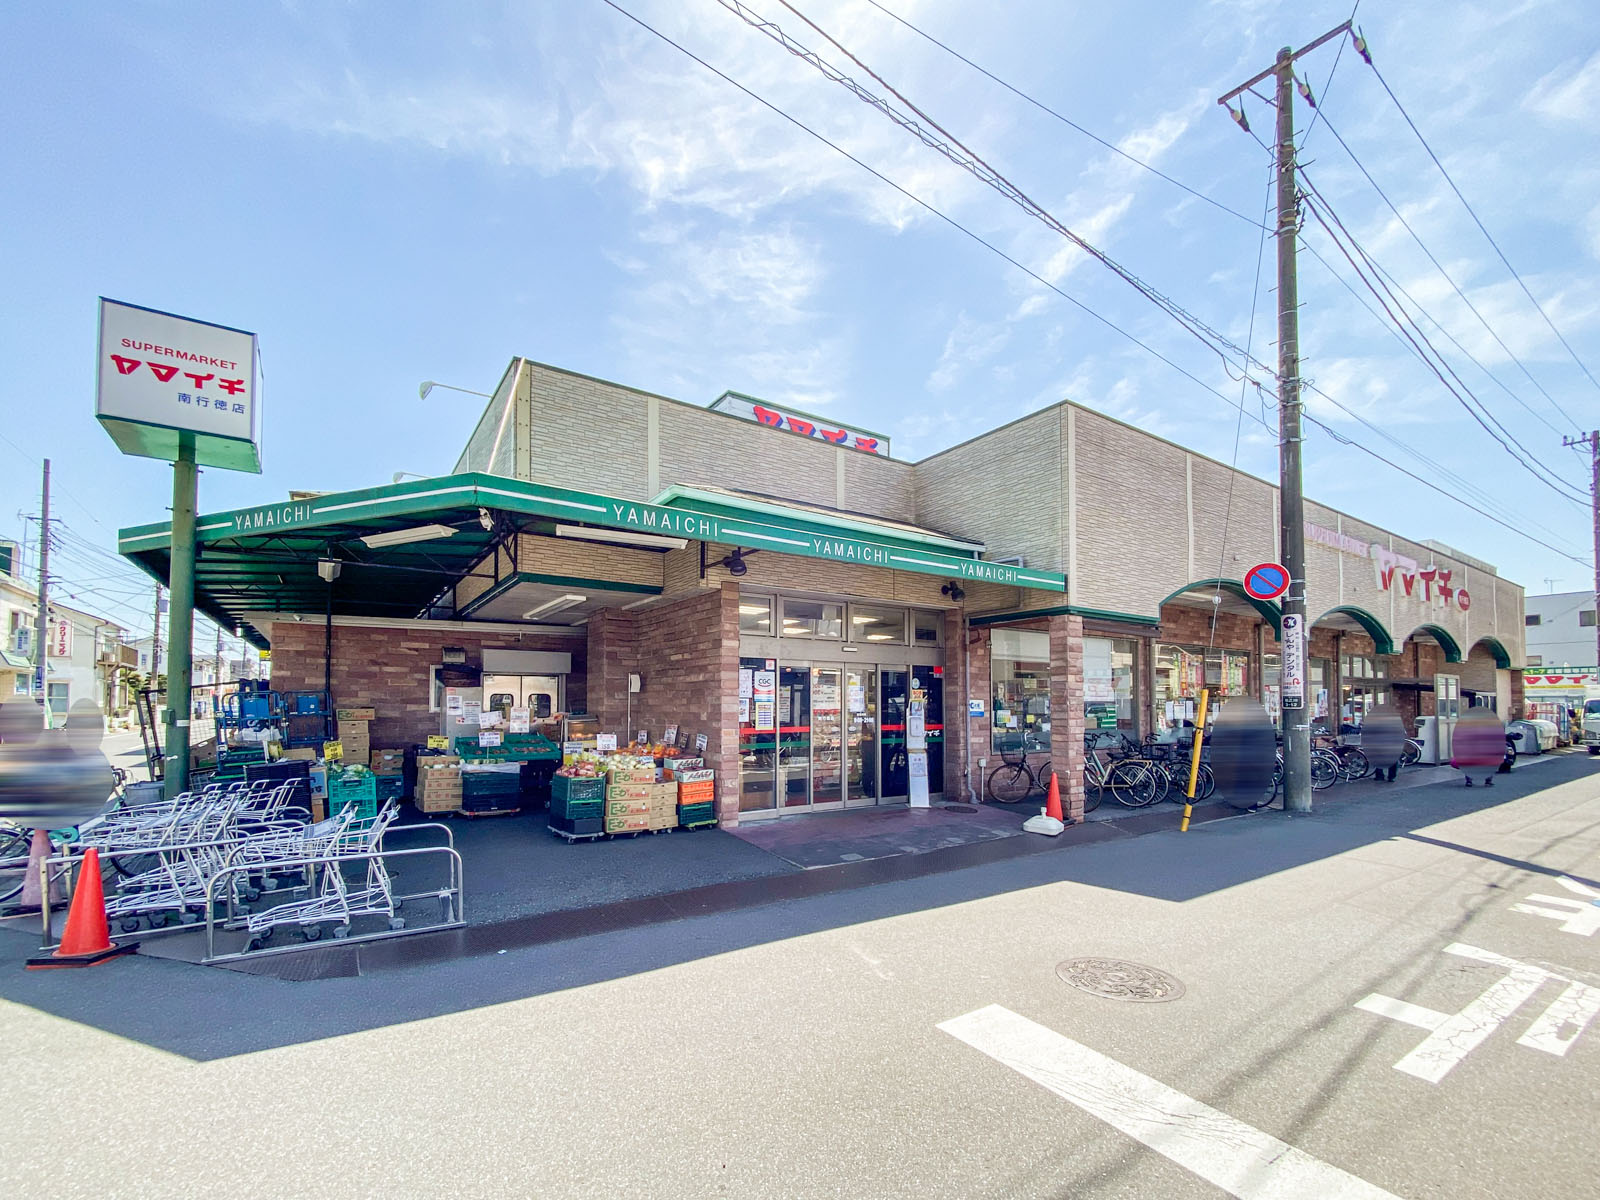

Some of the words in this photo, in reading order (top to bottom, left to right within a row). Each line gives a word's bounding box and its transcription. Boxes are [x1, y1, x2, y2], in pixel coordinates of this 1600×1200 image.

[121, 338, 237, 370] SUPERMARKET
[110, 354, 246, 395] ヤマイチ
[178, 392, 246, 414] 南行徳店
[235, 505, 310, 530] YAMAICHI
[613, 504, 718, 537] YAMAICHI
[813, 539, 888, 564] YAMAICHI
[960, 562, 1017, 582] YAMAICHI
